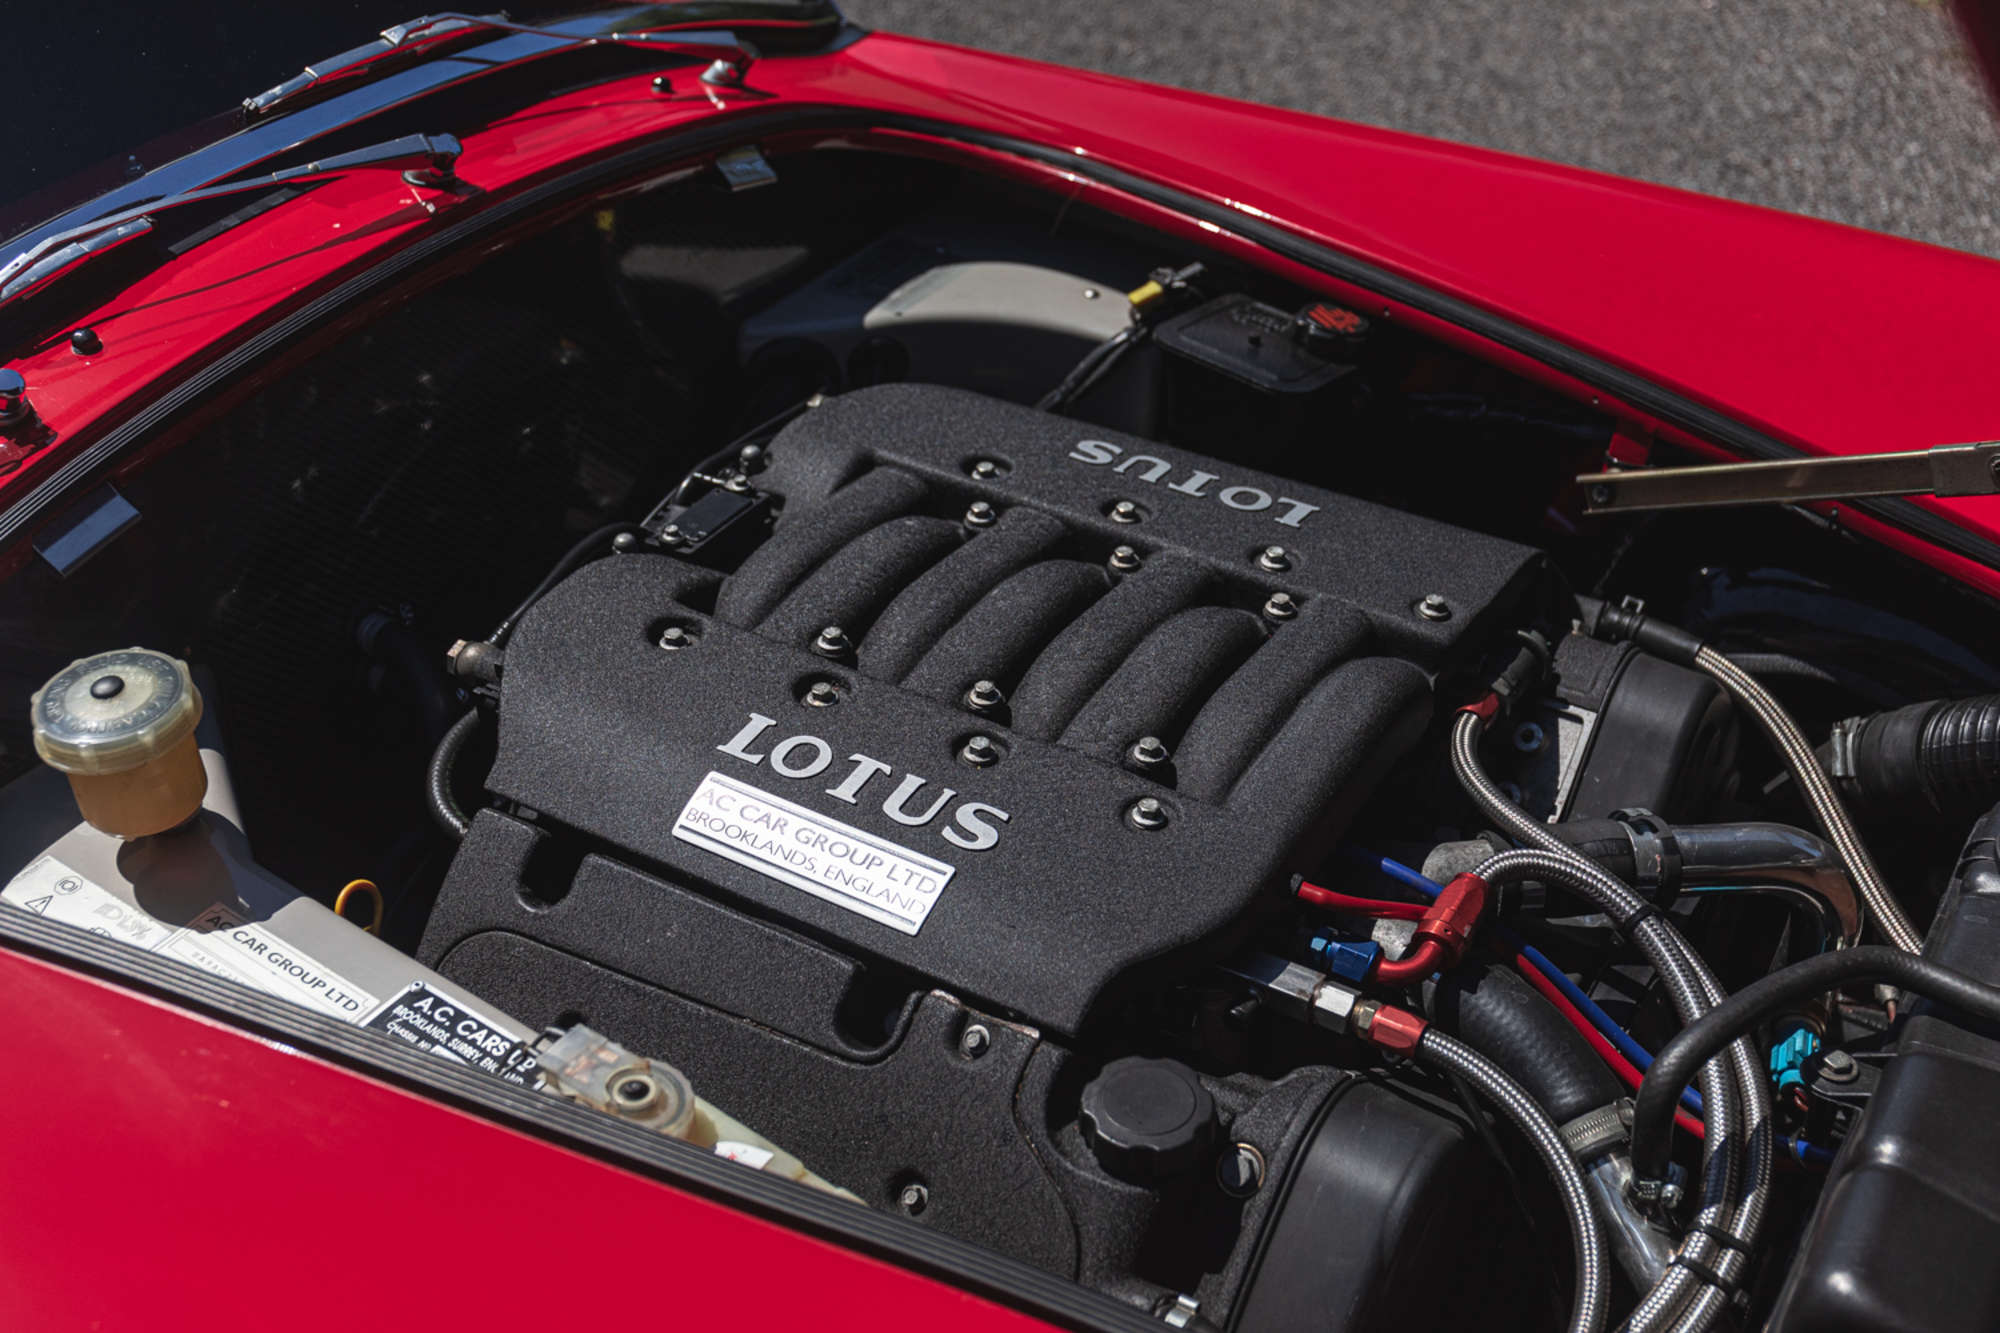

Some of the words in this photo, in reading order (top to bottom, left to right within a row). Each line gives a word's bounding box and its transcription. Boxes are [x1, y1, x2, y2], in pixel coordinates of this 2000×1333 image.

[1068, 439, 1321, 528] LOTUS
[716, 713, 1012, 851] LOTUS
[685, 807, 818, 875] BROOKLANDS,
[823, 865, 926, 915] ENGLAND
[695, 788, 737, 812] AC
[739, 803, 789, 836] CAR
[794, 827, 885, 871] GROUP
[886, 862, 938, 895] LTD
[206, 914, 235, 933] AC
[232, 929, 268, 956] CAR
[267, 952, 327, 990] GROUP
[325, 986, 360, 1013] LTD
[456, 1020, 511, 1056] CARS
